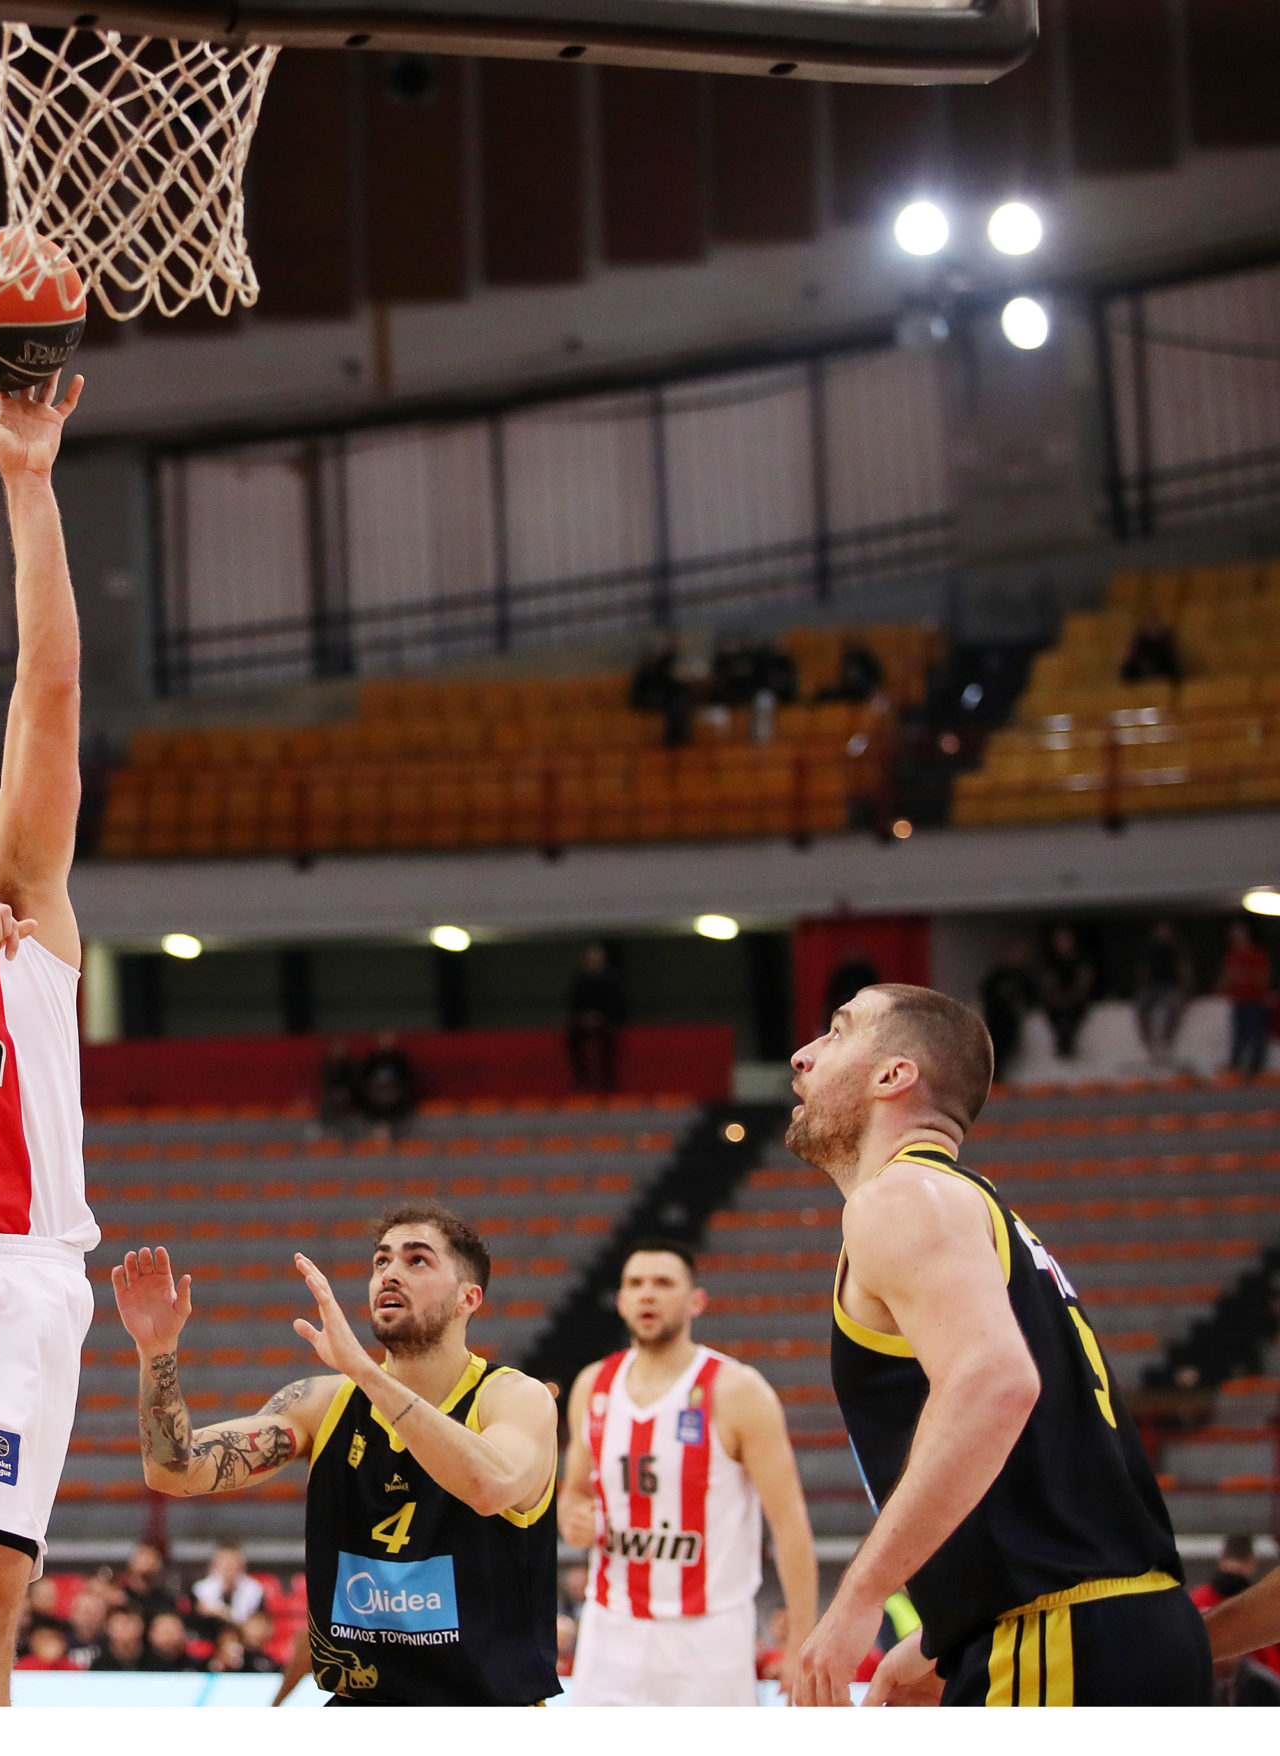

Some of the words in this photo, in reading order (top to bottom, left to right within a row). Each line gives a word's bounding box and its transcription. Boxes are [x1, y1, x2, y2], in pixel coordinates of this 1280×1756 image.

[618, 1455, 658, 1495] 16
[371, 1501, 417, 1554] 4
[346, 1571, 442, 1615] Midea
[330, 1624, 377, 1644] ΟΜΙΛΟΣ
[379, 1629, 460, 1646] ΤΟΥΡΝΙΚΙΩΤΗ
